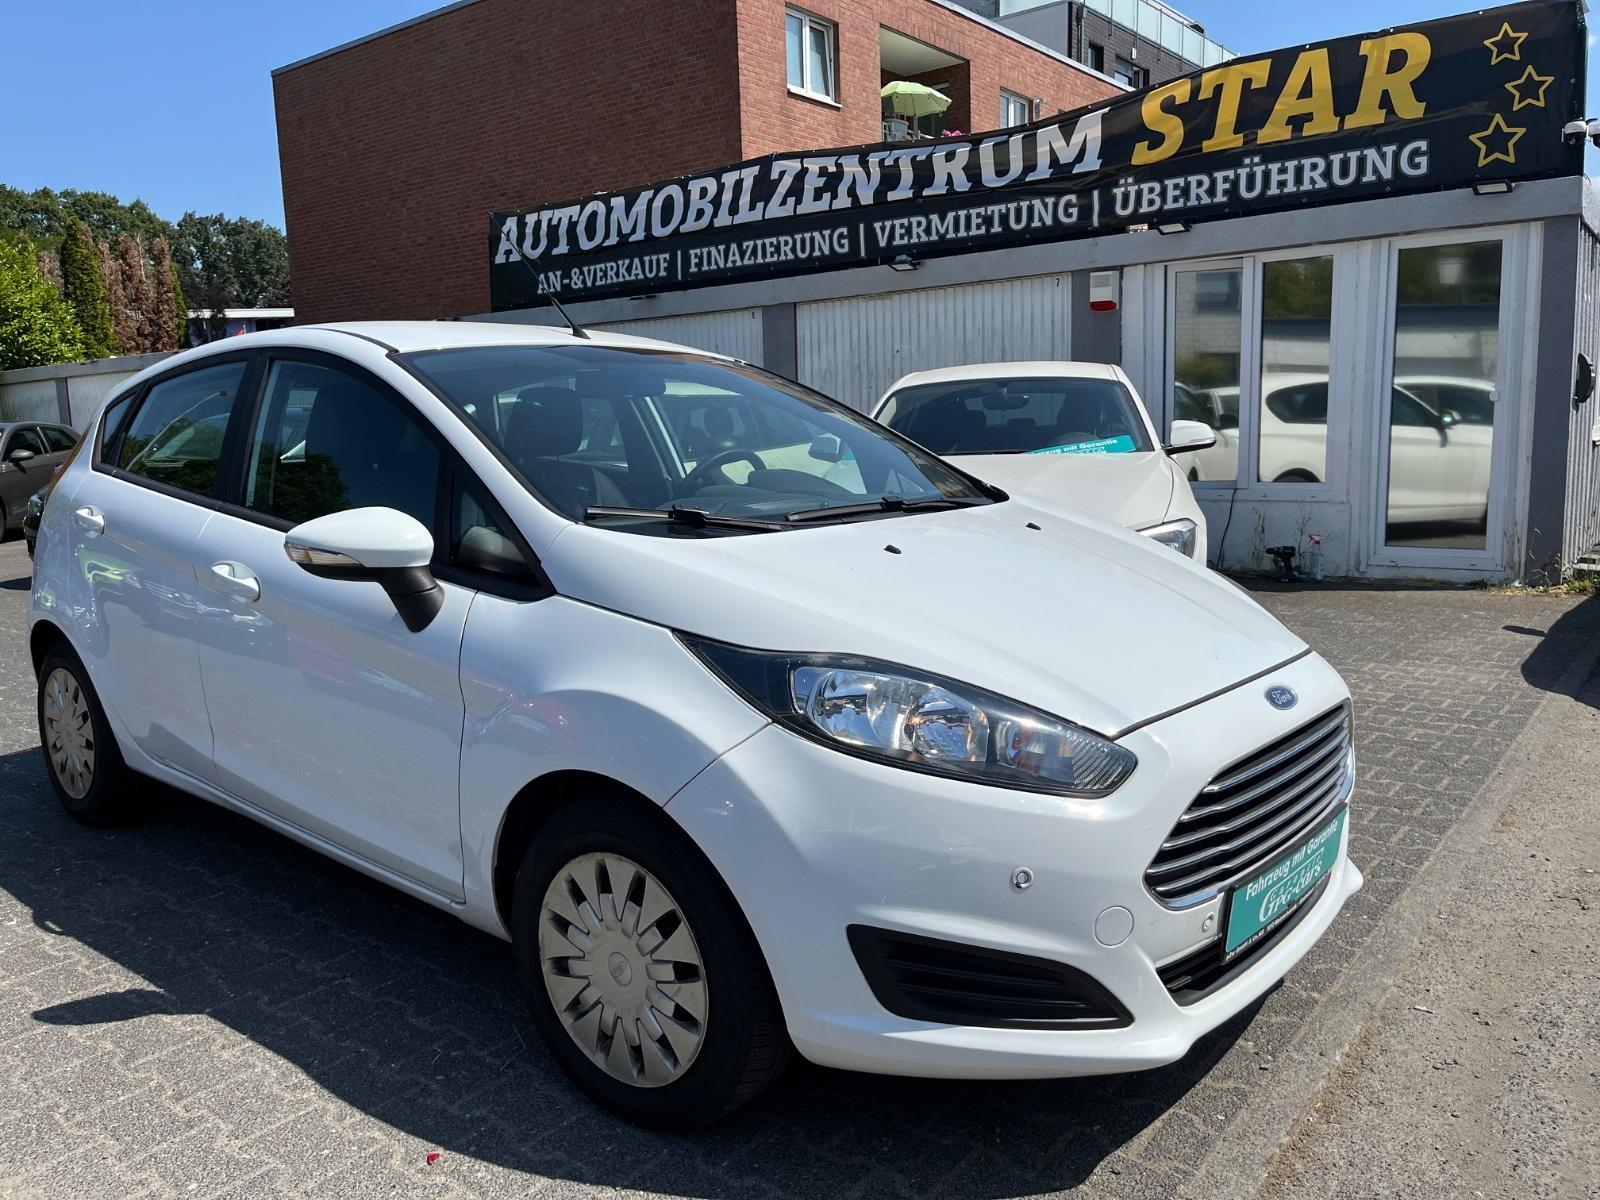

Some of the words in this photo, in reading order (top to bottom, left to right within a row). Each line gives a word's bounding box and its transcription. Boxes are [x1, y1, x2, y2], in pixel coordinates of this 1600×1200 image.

[495, 106, 1111, 264] AUTOMOBILZENTRUM
[1131, 32, 1431, 166] STAR
[537, 253, 670, 295] AN-&VERKAUF
[689, 227, 849, 273] FINAZIERUNG
[873, 195, 1078, 247] VERMIETUNG
[1112, 139, 1429, 216] ÜBERFÜHRUNG
[1245, 858, 1291, 901] Fahrzeug
[1291, 845, 1306, 868] mit
[1307, 818, 1338, 855] Garantie
